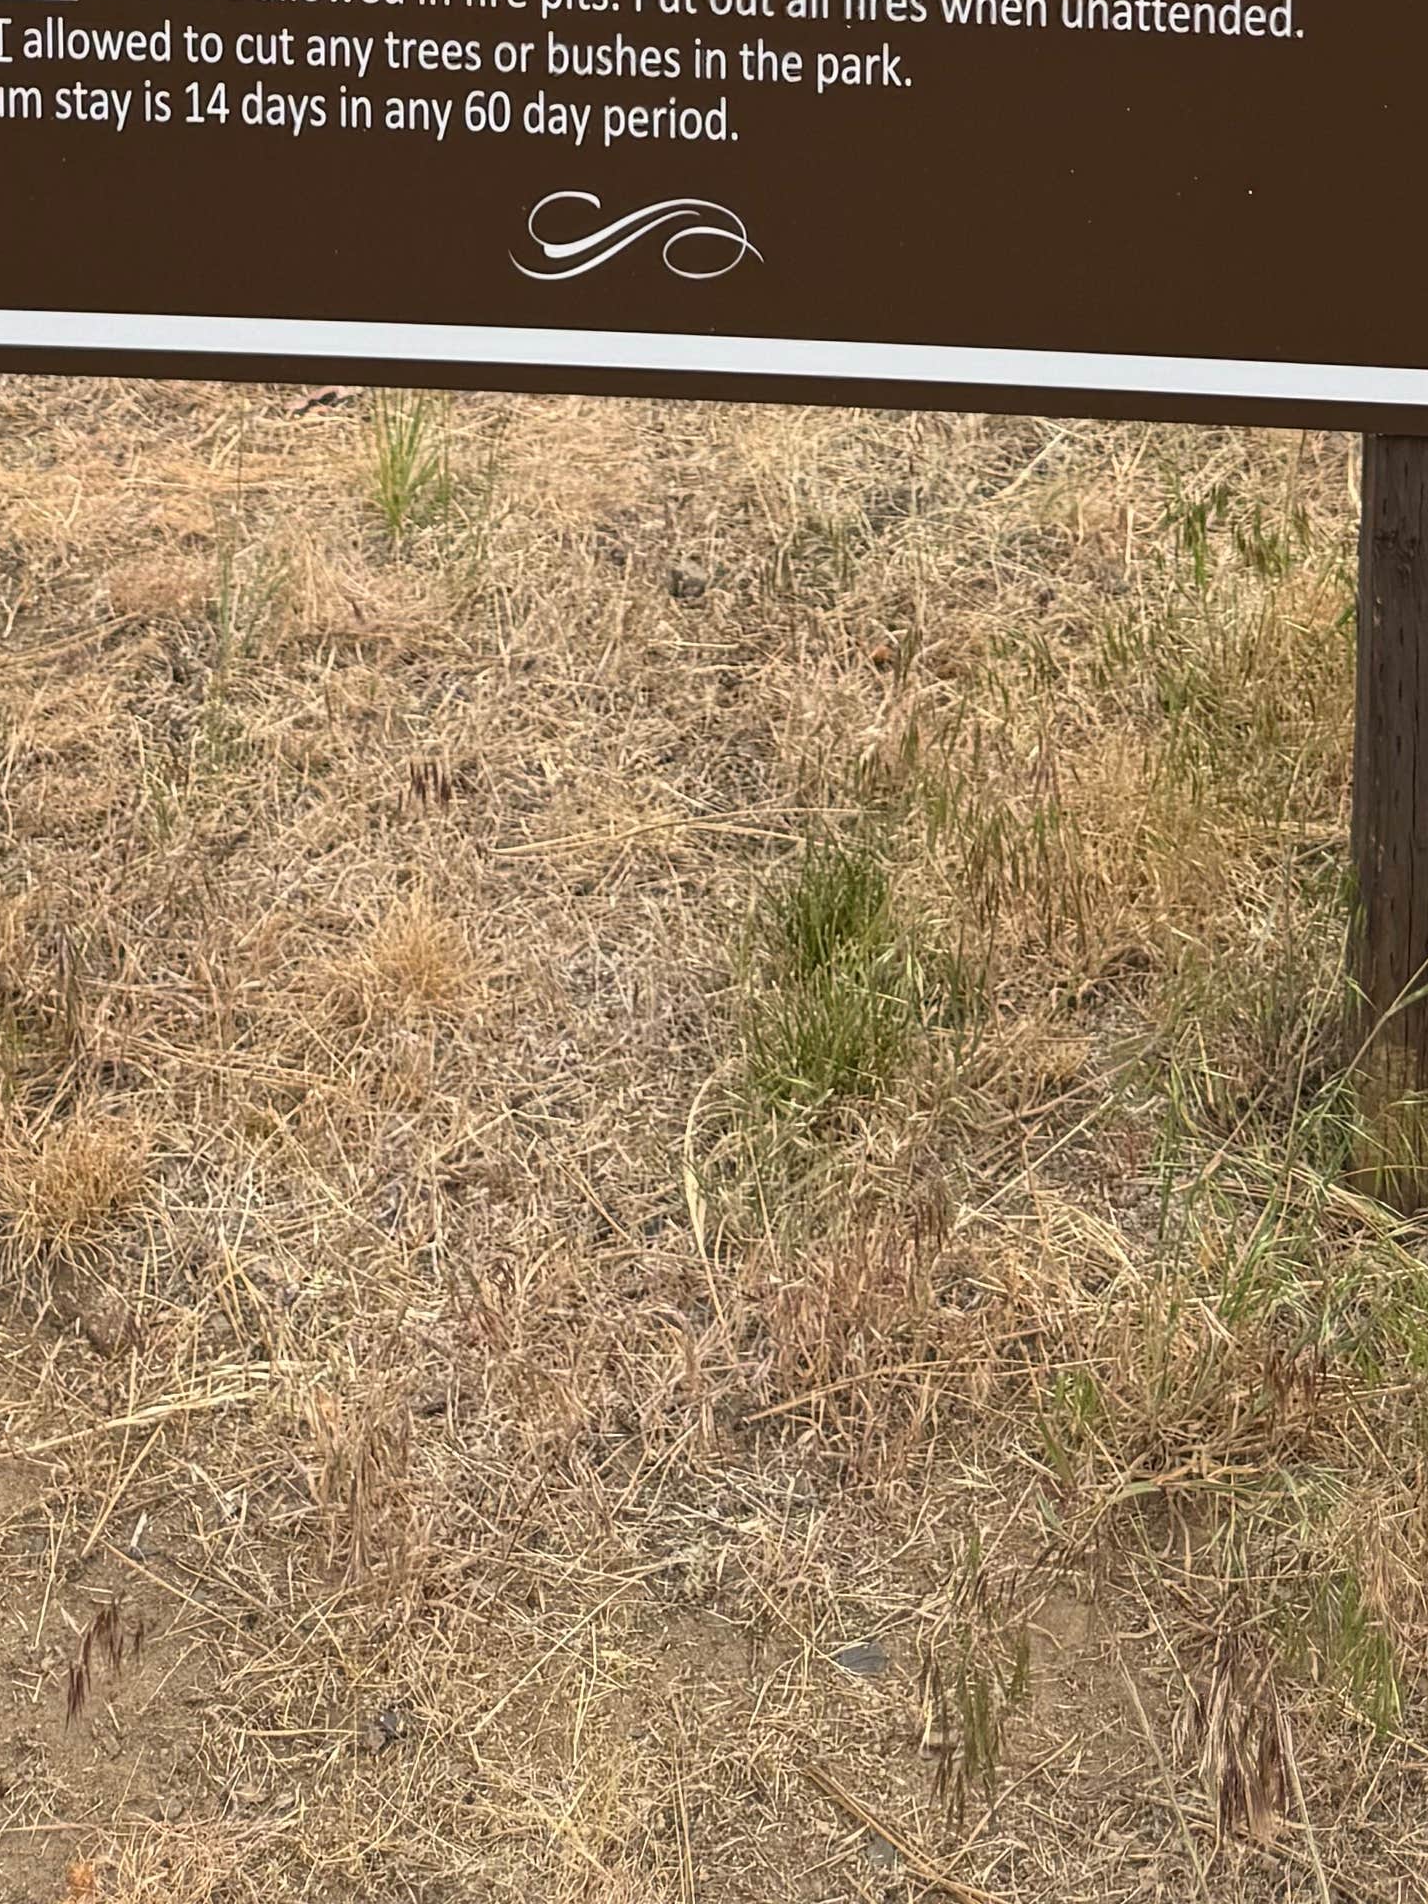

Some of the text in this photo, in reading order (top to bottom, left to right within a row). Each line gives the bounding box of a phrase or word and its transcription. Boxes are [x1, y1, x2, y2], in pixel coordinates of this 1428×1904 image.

[24, 17, 170, 61] allowed
[184, 26, 222, 63] to
[236, 29, 294, 65] cut
[307, 36, 373, 77] any
[385, 32, 481, 71] trees
[495, 42, 534, 72] or
[549, 31, 680, 77] bushes
[695, 38, 725, 79] in
[739, 39, 802, 82] the
[818, 43, 911, 93] park.
[56, 82, 131, 131] stay
[145, 80, 171, 122] is
[186, 82, 229, 123] 14
[242, 81, 326, 136] days
[341, 86, 371, 128] in
[386, 98, 452, 140] any
[465, 91, 510, 132] 60
[524, 91, 590, 145] day
[605, 97, 738, 146] period.
